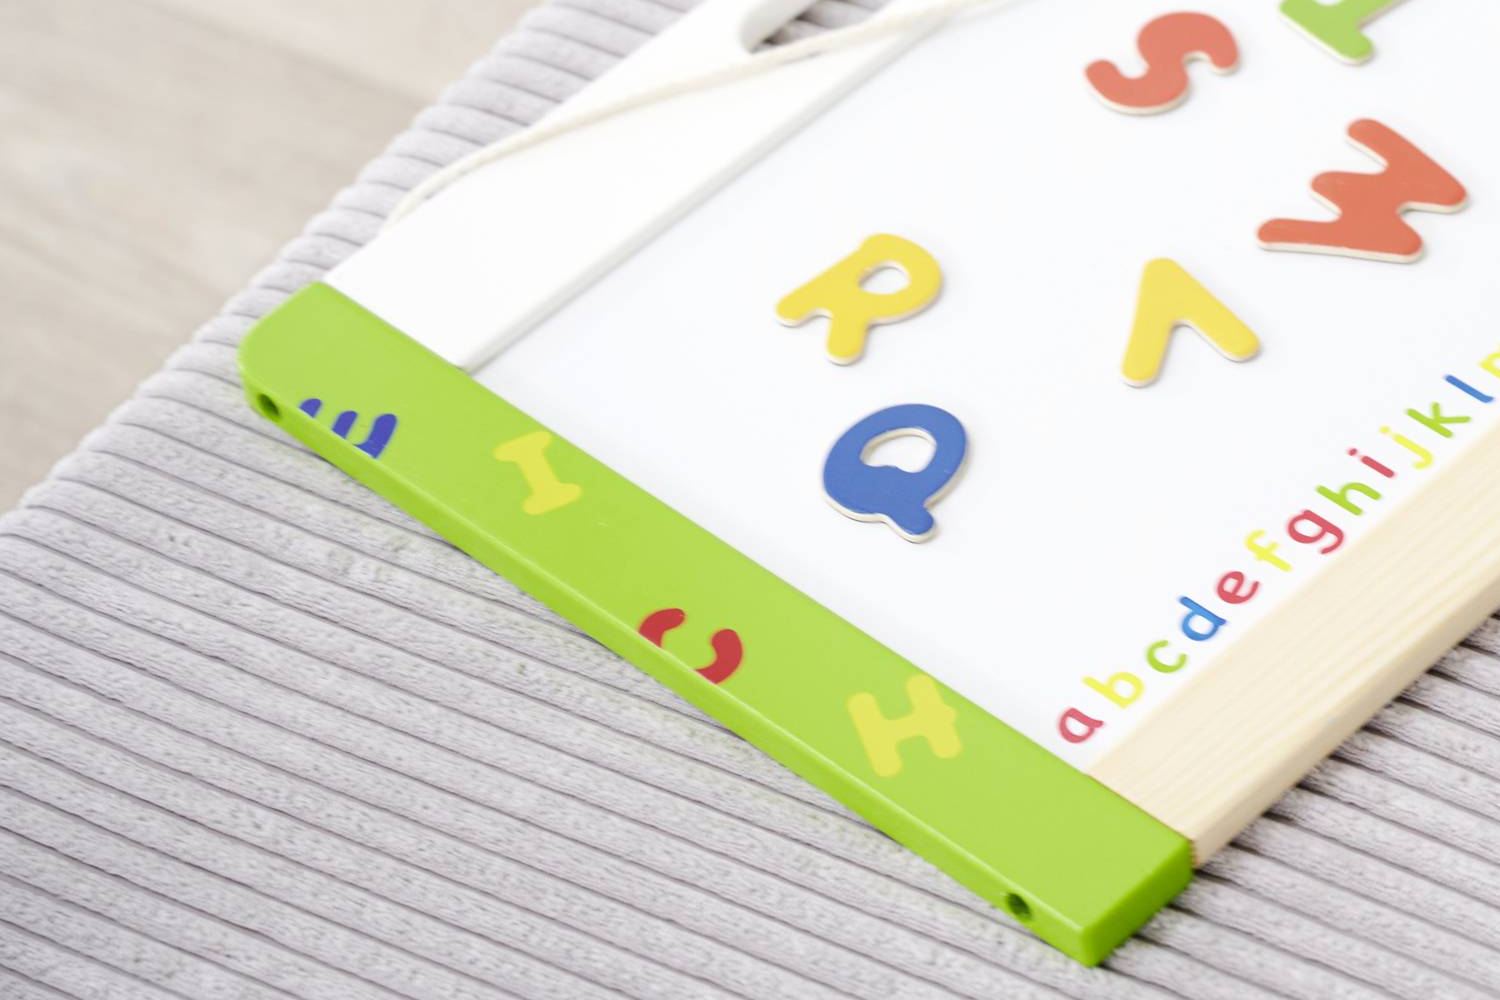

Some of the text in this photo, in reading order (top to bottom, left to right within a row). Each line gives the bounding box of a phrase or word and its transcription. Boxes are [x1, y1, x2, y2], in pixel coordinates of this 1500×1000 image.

[1084, 10, 1240, 113] S
[775, 233, 943, 362] R
[822, 403, 970, 540] Q
[847, 674, 962, 778] H
